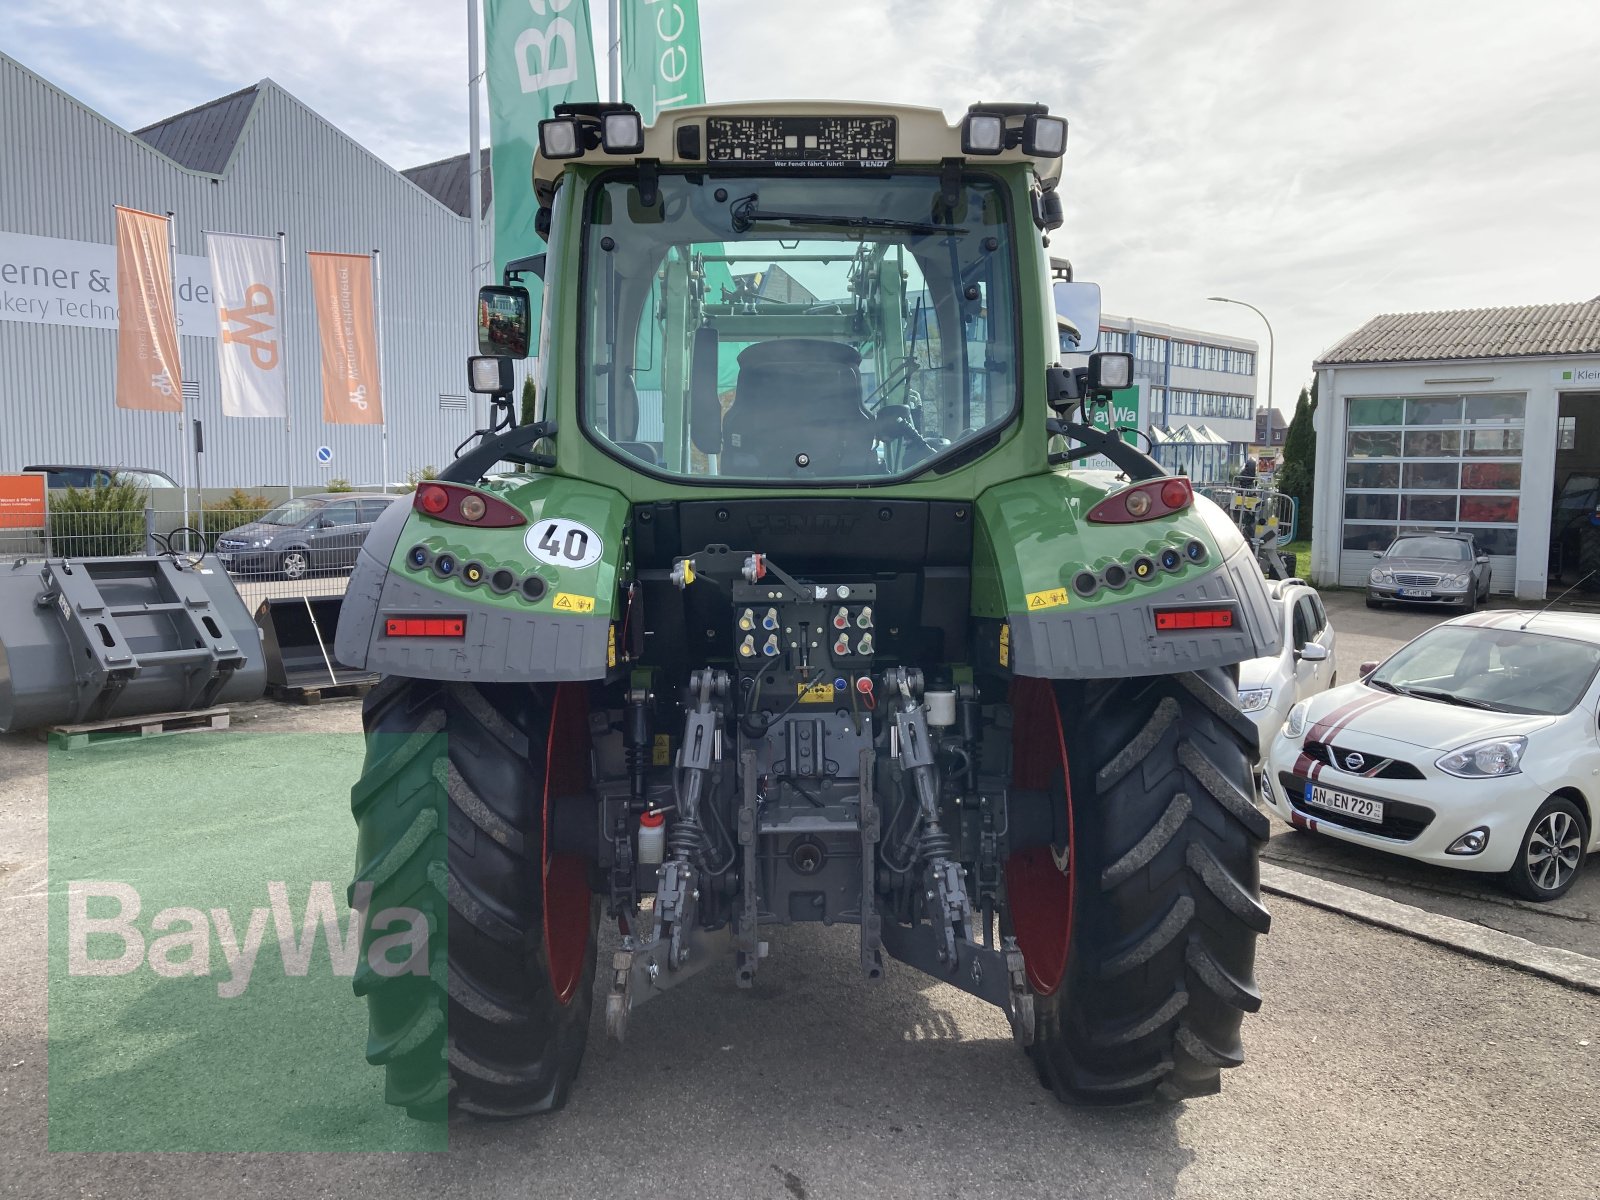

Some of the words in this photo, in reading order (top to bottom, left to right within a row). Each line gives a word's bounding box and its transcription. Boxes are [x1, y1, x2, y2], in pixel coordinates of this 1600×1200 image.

[514, 0, 578, 94] B
[645, 0, 688, 126] Tec
[774, 160, 787, 168] Wer
[860, 160, 889, 168] FENDT
[1, 263, 80, 290] erner
[88, 269, 111, 293] &
[0, 290, 49, 319] kery
[537, 523, 589, 561] 40
[1312, 787, 1327, 804] AN
[1333, 793, 1349, 810] EN
[1351, 798, 1374, 816] 729
